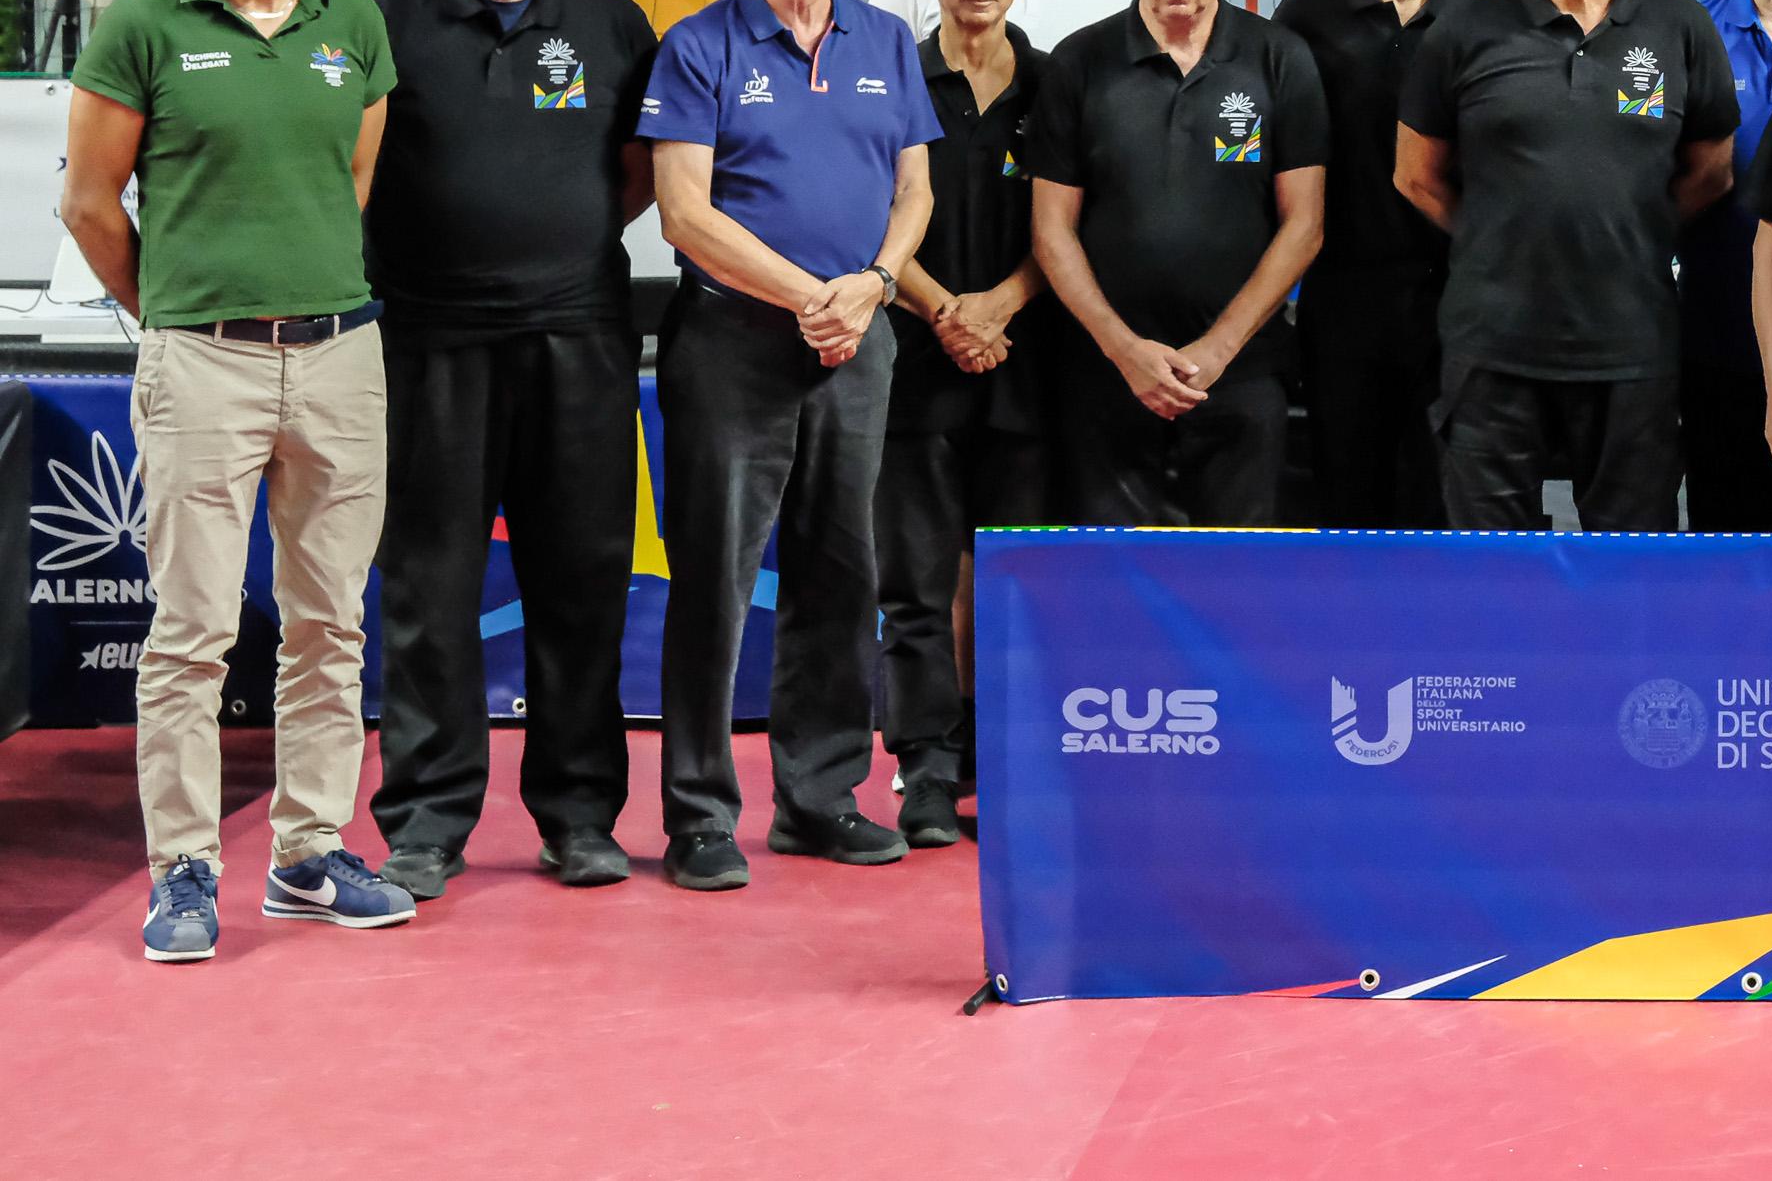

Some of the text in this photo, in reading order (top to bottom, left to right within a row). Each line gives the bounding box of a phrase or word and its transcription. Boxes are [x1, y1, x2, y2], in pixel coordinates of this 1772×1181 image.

[1416, 676, 1517, 689] FEDERAZIONE
[1416, 688, 1483, 700] ITALIANA
[1062, 687, 1219, 733] CUS
[1416, 700, 1446, 708] DELLO
[1416, 708, 1463, 720] SPORT
[1416, 721, 1526, 732] UNIVERSITARIO
[1061, 732, 1221, 756] SALERNO
[1345, 738, 1400, 759] FEDERCUSI
[1717, 742, 1748, 769] DI
